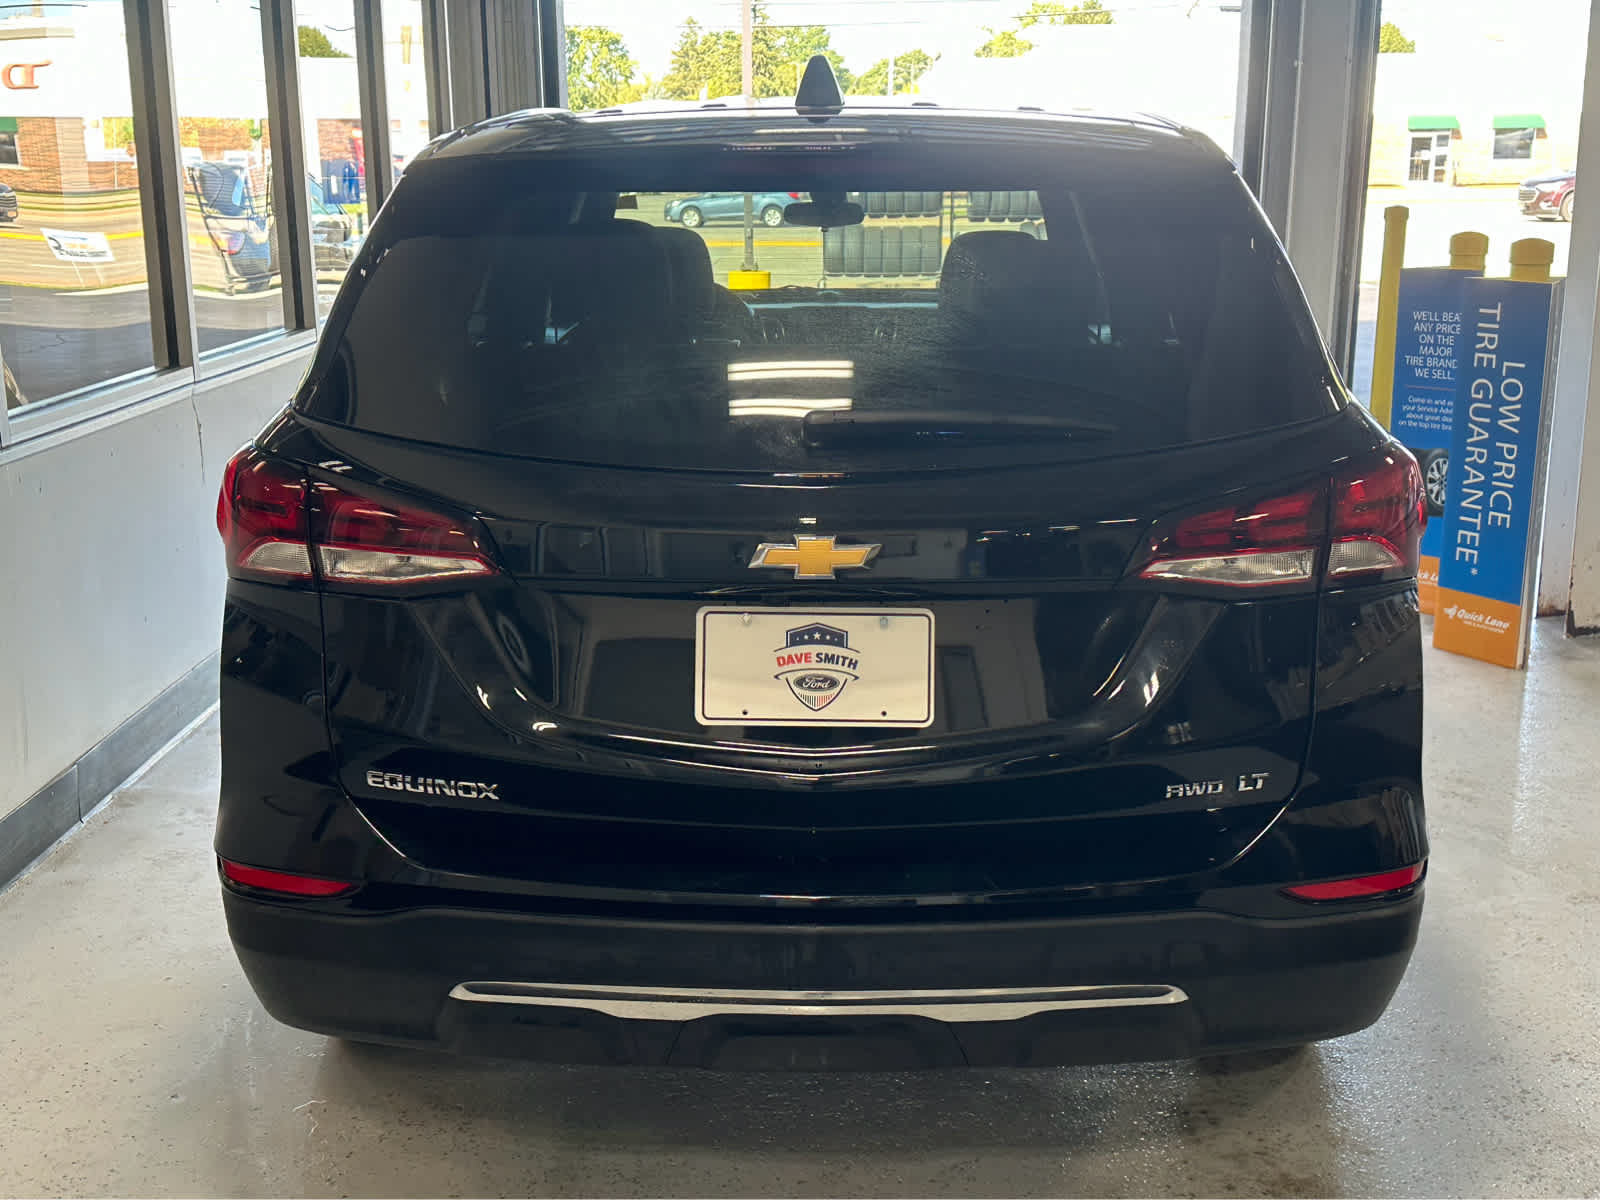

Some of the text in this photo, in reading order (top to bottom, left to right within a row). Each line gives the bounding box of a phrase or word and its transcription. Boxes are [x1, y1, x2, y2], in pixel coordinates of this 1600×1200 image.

[1413, 311, 1439, 321] WE'LL
[1414, 322, 1461, 334] ANY PRICE
[1419, 334, 1454, 346] ON THE
[1473, 302, 1501, 369] TIRE
[1419, 346, 1452, 357] MAJOR
[1405, 355, 1424, 366] TIRE
[1415, 368, 1430, 378] WE
[1408, 395, 1425, 404] Come
[1488, 361, 1526, 529] LOW PRICE
[1457, 609, 1484, 622] Quick
[1484, 615, 1510, 629] Lane
[776, 652, 858, 670] DAVE SMITH
[802, 677, 830, 688] Ford
[367, 770, 499, 800] EQUINOX
[1166, 772, 1270, 798] AWD LT
